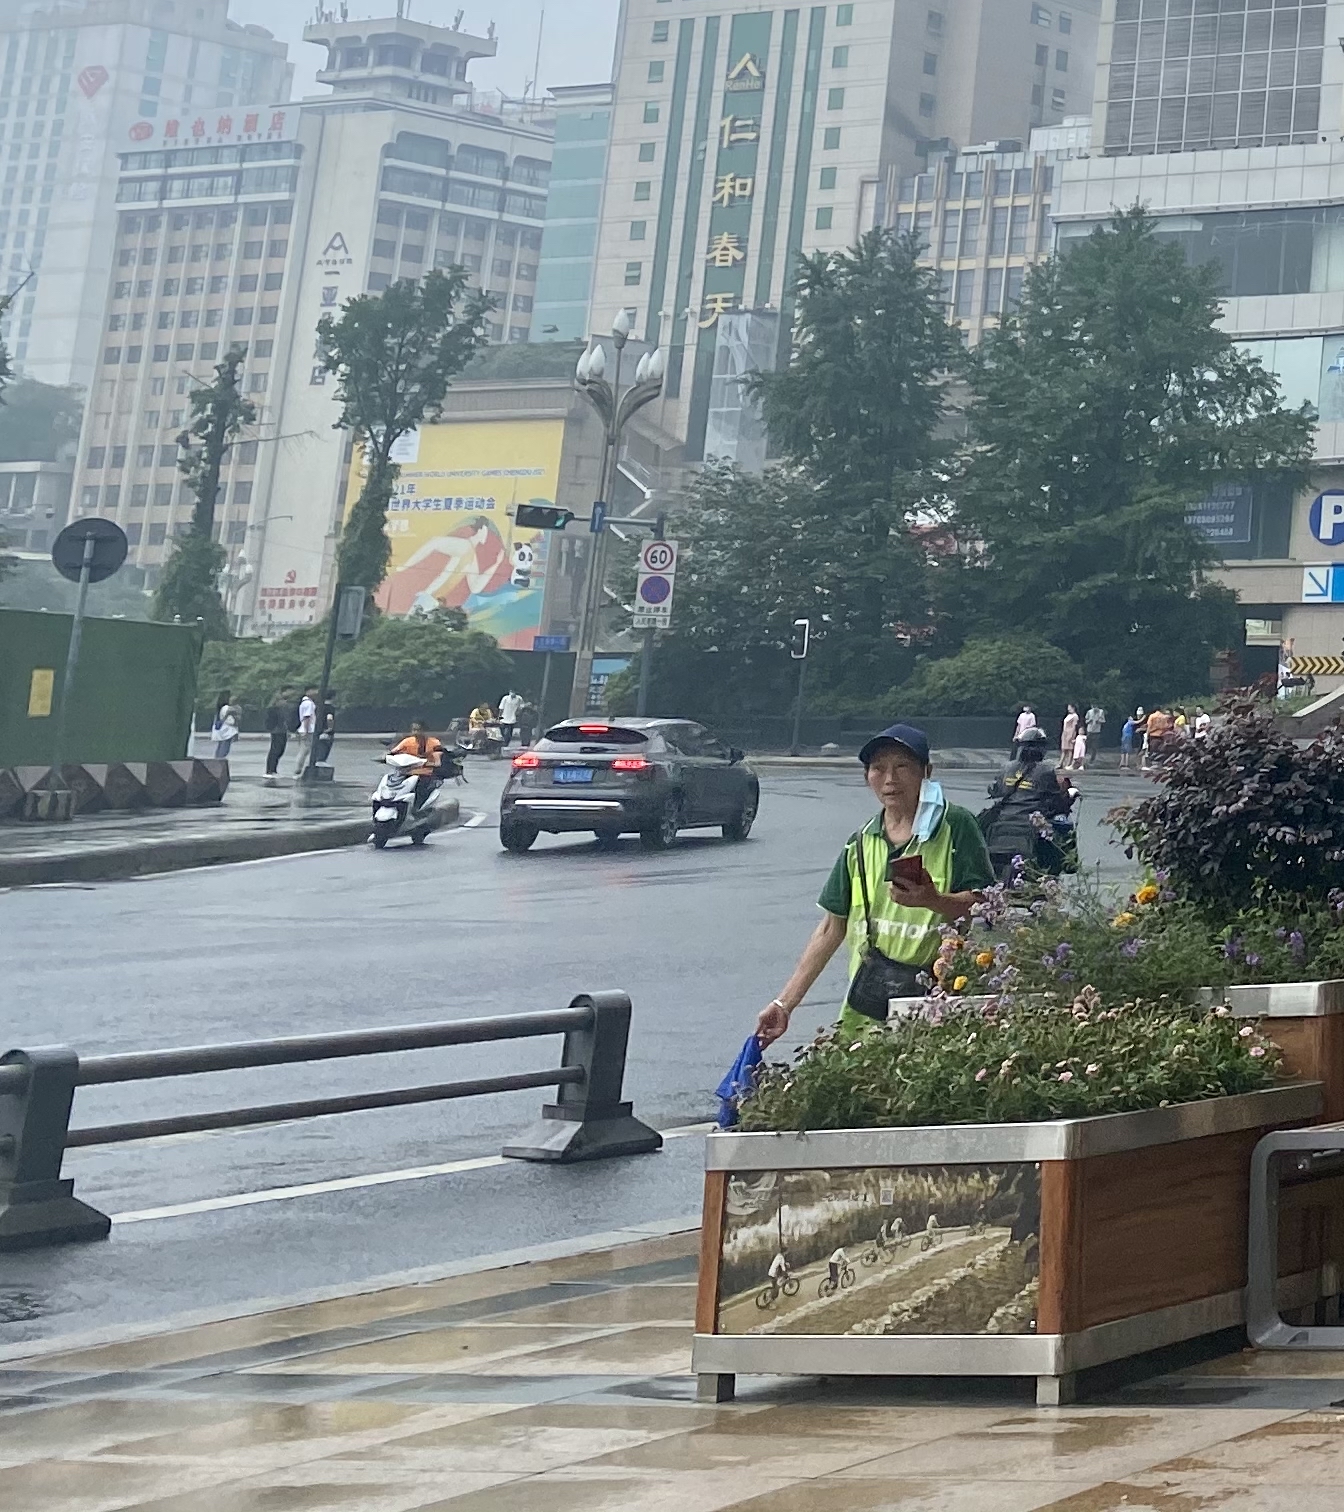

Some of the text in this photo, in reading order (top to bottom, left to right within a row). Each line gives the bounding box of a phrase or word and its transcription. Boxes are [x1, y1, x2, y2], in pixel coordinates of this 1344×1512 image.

[698, 115, 757, 328] 仁和春天
[650, 549, 668, 564] 60
